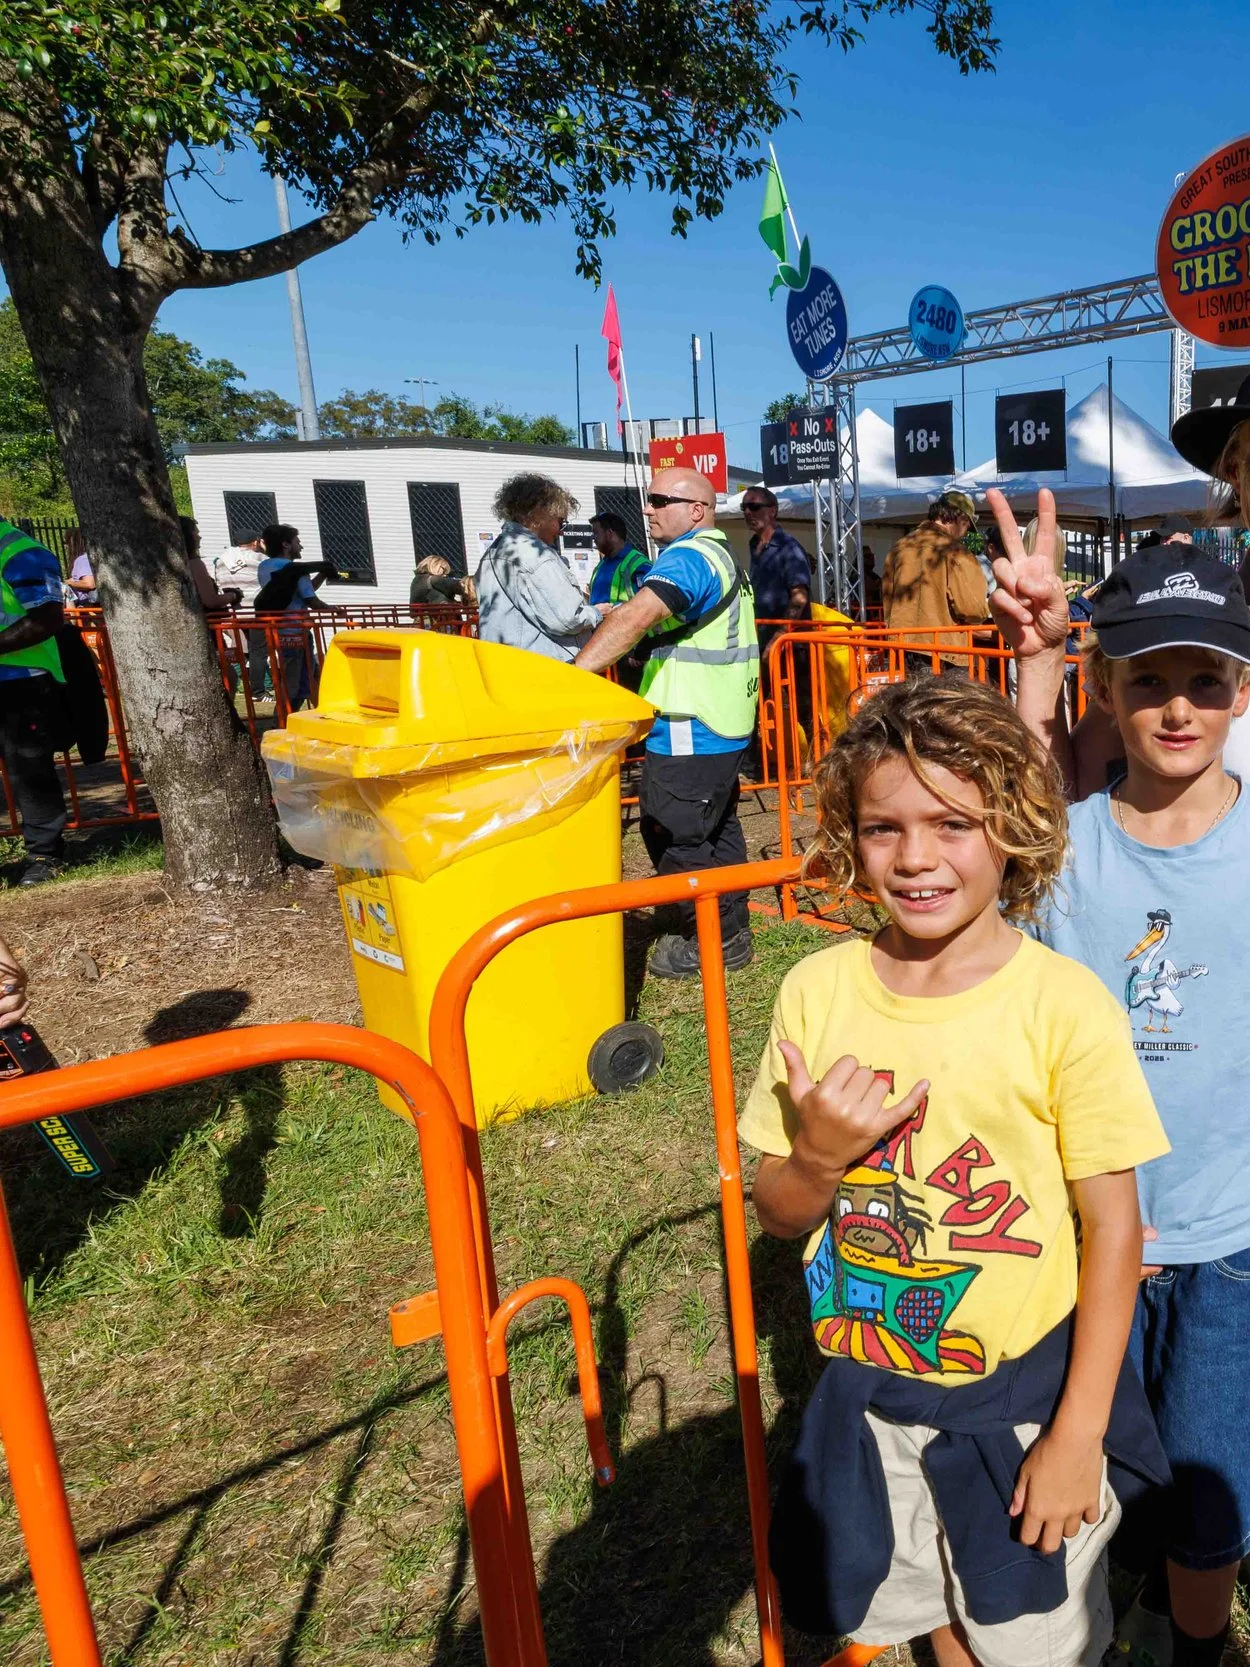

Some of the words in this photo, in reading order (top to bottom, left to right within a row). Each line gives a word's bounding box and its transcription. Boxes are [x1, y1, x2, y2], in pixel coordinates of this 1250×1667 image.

[1180, 168, 1213, 210] GREAT
[1172, 249, 1238, 293] THE
[790, 309, 812, 345] EAT
[808, 284, 837, 324] MORE
[916, 299, 957, 335] 2480
[1218, 320, 1226, 334] 9
[804, 317, 837, 359] TUNES
[804, 418, 820, 436] No
[905, 428, 941, 453] 18+
[1008, 419, 1051, 446] 18+
[790, 438, 836, 454] Pass-Outs
[693, 454, 718, 474] VIP
[1144, 1042, 1166, 1050] MILLER
[1168, 1043, 1193, 1051] CLASSIC
[52, 1136, 94, 1173] SUPER
[924, 1134, 1043, 1258] BOY
